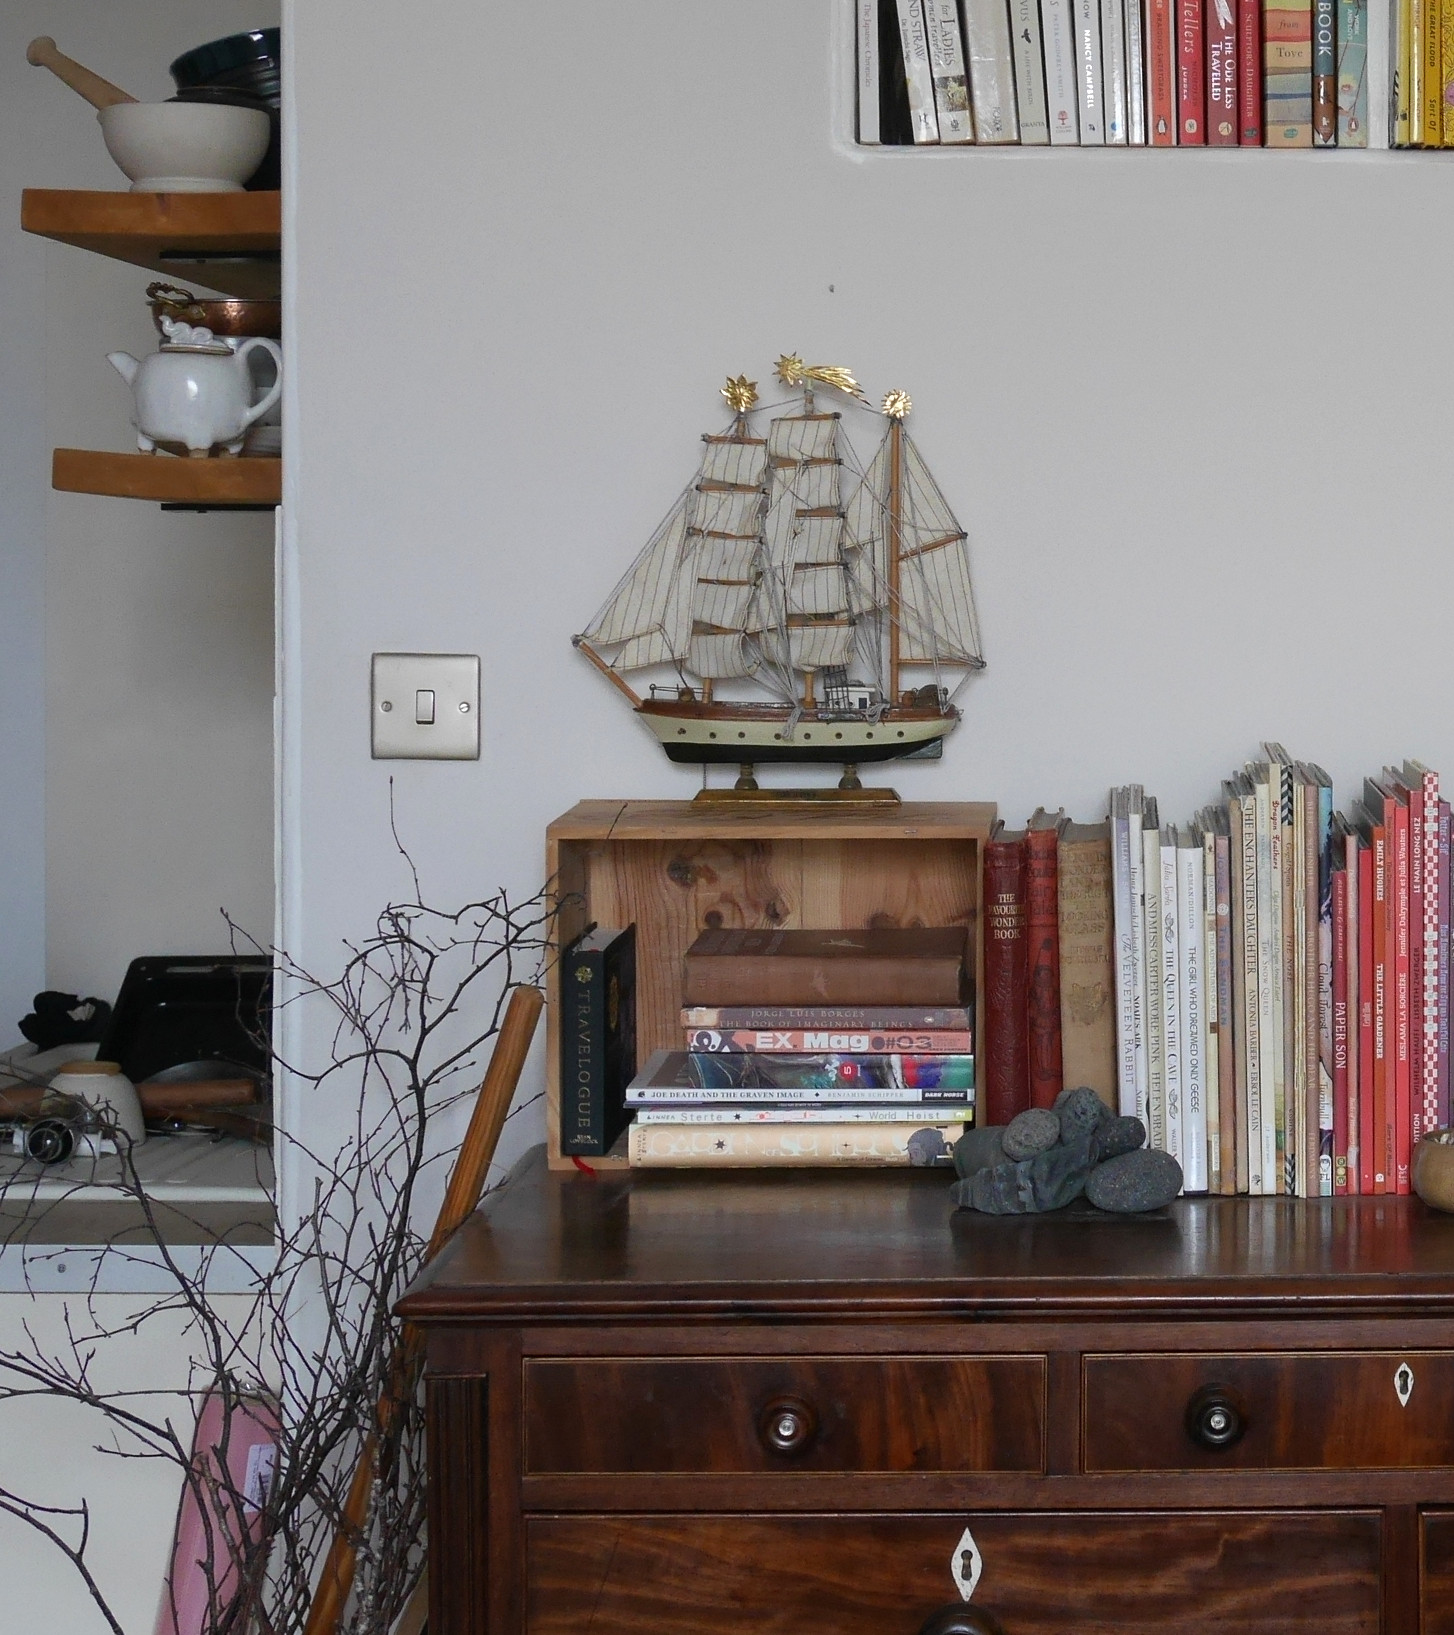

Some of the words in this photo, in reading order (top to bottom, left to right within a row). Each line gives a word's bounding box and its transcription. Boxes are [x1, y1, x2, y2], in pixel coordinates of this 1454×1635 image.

[863, 3, 872, 17] The
[941, 4, 951, 17] for
[862, 18, 873, 48] Japanese
[1184, 1, 1199, 54] Tellers
[1278, 20, 1299, 30] from
[1317, 2, 1332, 56] BOOK
[911, 21, 926, 61] STRAW
[939, 18, 956, 67] LADIES
[1084, 29, 1092, 61] NANCY
[1225, 33, 1236, 56] THE
[1245, 13, 1254, 66] SCULPTOR'S
[863, 50, 873, 87] Chronicles
[1211, 41, 1222, 101] TRAVELLED
[1225, 59, 1236, 83] ODE
[1085, 64, 1095, 109] CAMPBELL
[1225, 86, 1236, 109] LESS
[1245, 68, 1255, 117] DAUGHTER
[1429, 98, 1437, 117] Sort
[1429, 120, 1437, 131] Of
[1244, 805, 1255, 829] THE
[1270, 800, 1280, 831] Dragon
[1413, 817, 1421, 834] NEZ
[1272, 834, 1281, 870] Feathers
[1376, 839, 1385, 866] EMILY
[1413, 835, 1421, 859] LONG
[1216, 853, 1226, 894] JOYCE
[1376, 867, 1385, 902] HUGHES
[1413, 861, 1421, 883] NAIN
[997, 893, 1016, 904] THE
[1186, 861, 1195, 930] NORMAN/DILLON
[1413, 884, 1421, 894] LE
[1147, 893, 1158, 919] AND
[988, 917, 1027, 927] WONDER
[993, 928, 1022, 940] BOOK
[1148, 920, 1158, 949] MISS
[1218, 926, 1228, 953] THE
[1246, 912, 1257, 975] DAUGHTER
[1261, 939, 1270, 958] THE
[1165, 949, 1175, 971] THE
[1187, 946, 1197, 965] THE
[1149, 949, 1159, 997] CARTER
[1187, 966, 1198, 986] GIRL
[1262, 961, 1270, 985] SNOW
[1318, 962, 1330, 994] Cloud
[1376, 963, 1384, 982] THE
[1122, 955, 1134, 1032] VELVETEEN
[1163, 972, 1177, 1011] QUEEN
[1188, 988, 1198, 1010] WHO
[1219, 958, 1230, 1026] SANDMAN
[1261, 987, 1271, 1016] QUEEN
[1375, 983, 1384, 1015] LITTLE
[751, 1010, 788, 1019] JORGE
[789, 1010, 816, 1018] LUIS
[820, 1010, 866, 1018] BORGES
[1150, 998, 1160, 1033] WORE
[1167, 1014, 1176, 1027] IN
[1248, 988, 1258, 1028] ANTONIA
[1318, 999, 1331, 1031] Forest
[1335, 1001, 1346, 1041] PAPER
[719, 1020, 743, 1028] THE
[745, 1020, 775, 1028] BOOK
[778, 1020, 793, 1028] OF
[796, 1020, 867, 1028] IMAGINARY
[870, 1020, 914, 1028] BEINGS
[1189, 1012, 1199, 1057] DREAMED
[1375, 1016, 1384, 1059] GARDENER
[755, 1033, 797, 1049] EX.
[803, 1032, 870, 1052] Mag
[1150, 1035, 1161, 1064] PINK
[1167, 1029, 1177, 1051] THE
[1249, 1030, 1258, 1061] BARBER
[577, 989, 592, 1128] TRAVELOGUE
[1124, 1038, 1135, 1085] RABBIT
[1167, 1053, 1178, 1084] CAVE
[1189, 1058, 1199, 1082] ONLY
[1335, 1044, 1346, 1069] SON
[650, 1091, 666, 1099] JOE
[667, 1091, 699, 1099] DEATH
[700, 1091, 719, 1099] AND
[720, 1091, 738, 1099] THE
[740, 1091, 775, 1099] GRAVEN
[776, 1091, 805, 1099] IMAGE
[827, 1091, 866, 1099] BENJAMIN
[1151, 1071, 1162, 1112] HELEN
[1250, 1071, 1259, 1097] ERROL
[1190, 1083, 1200, 1113] GEESE
[1250, 1098, 1259, 1109] LE
[646, 1113, 676, 1121] LINNEA
[680, 1111, 723, 1122] Sterte
[868, 1111, 897, 1121] World
[906, 1111, 941, 1121] Heist
[1250, 1110, 1259, 1132] CAIN
[1170, 1128, 1178, 1152] WALKER
